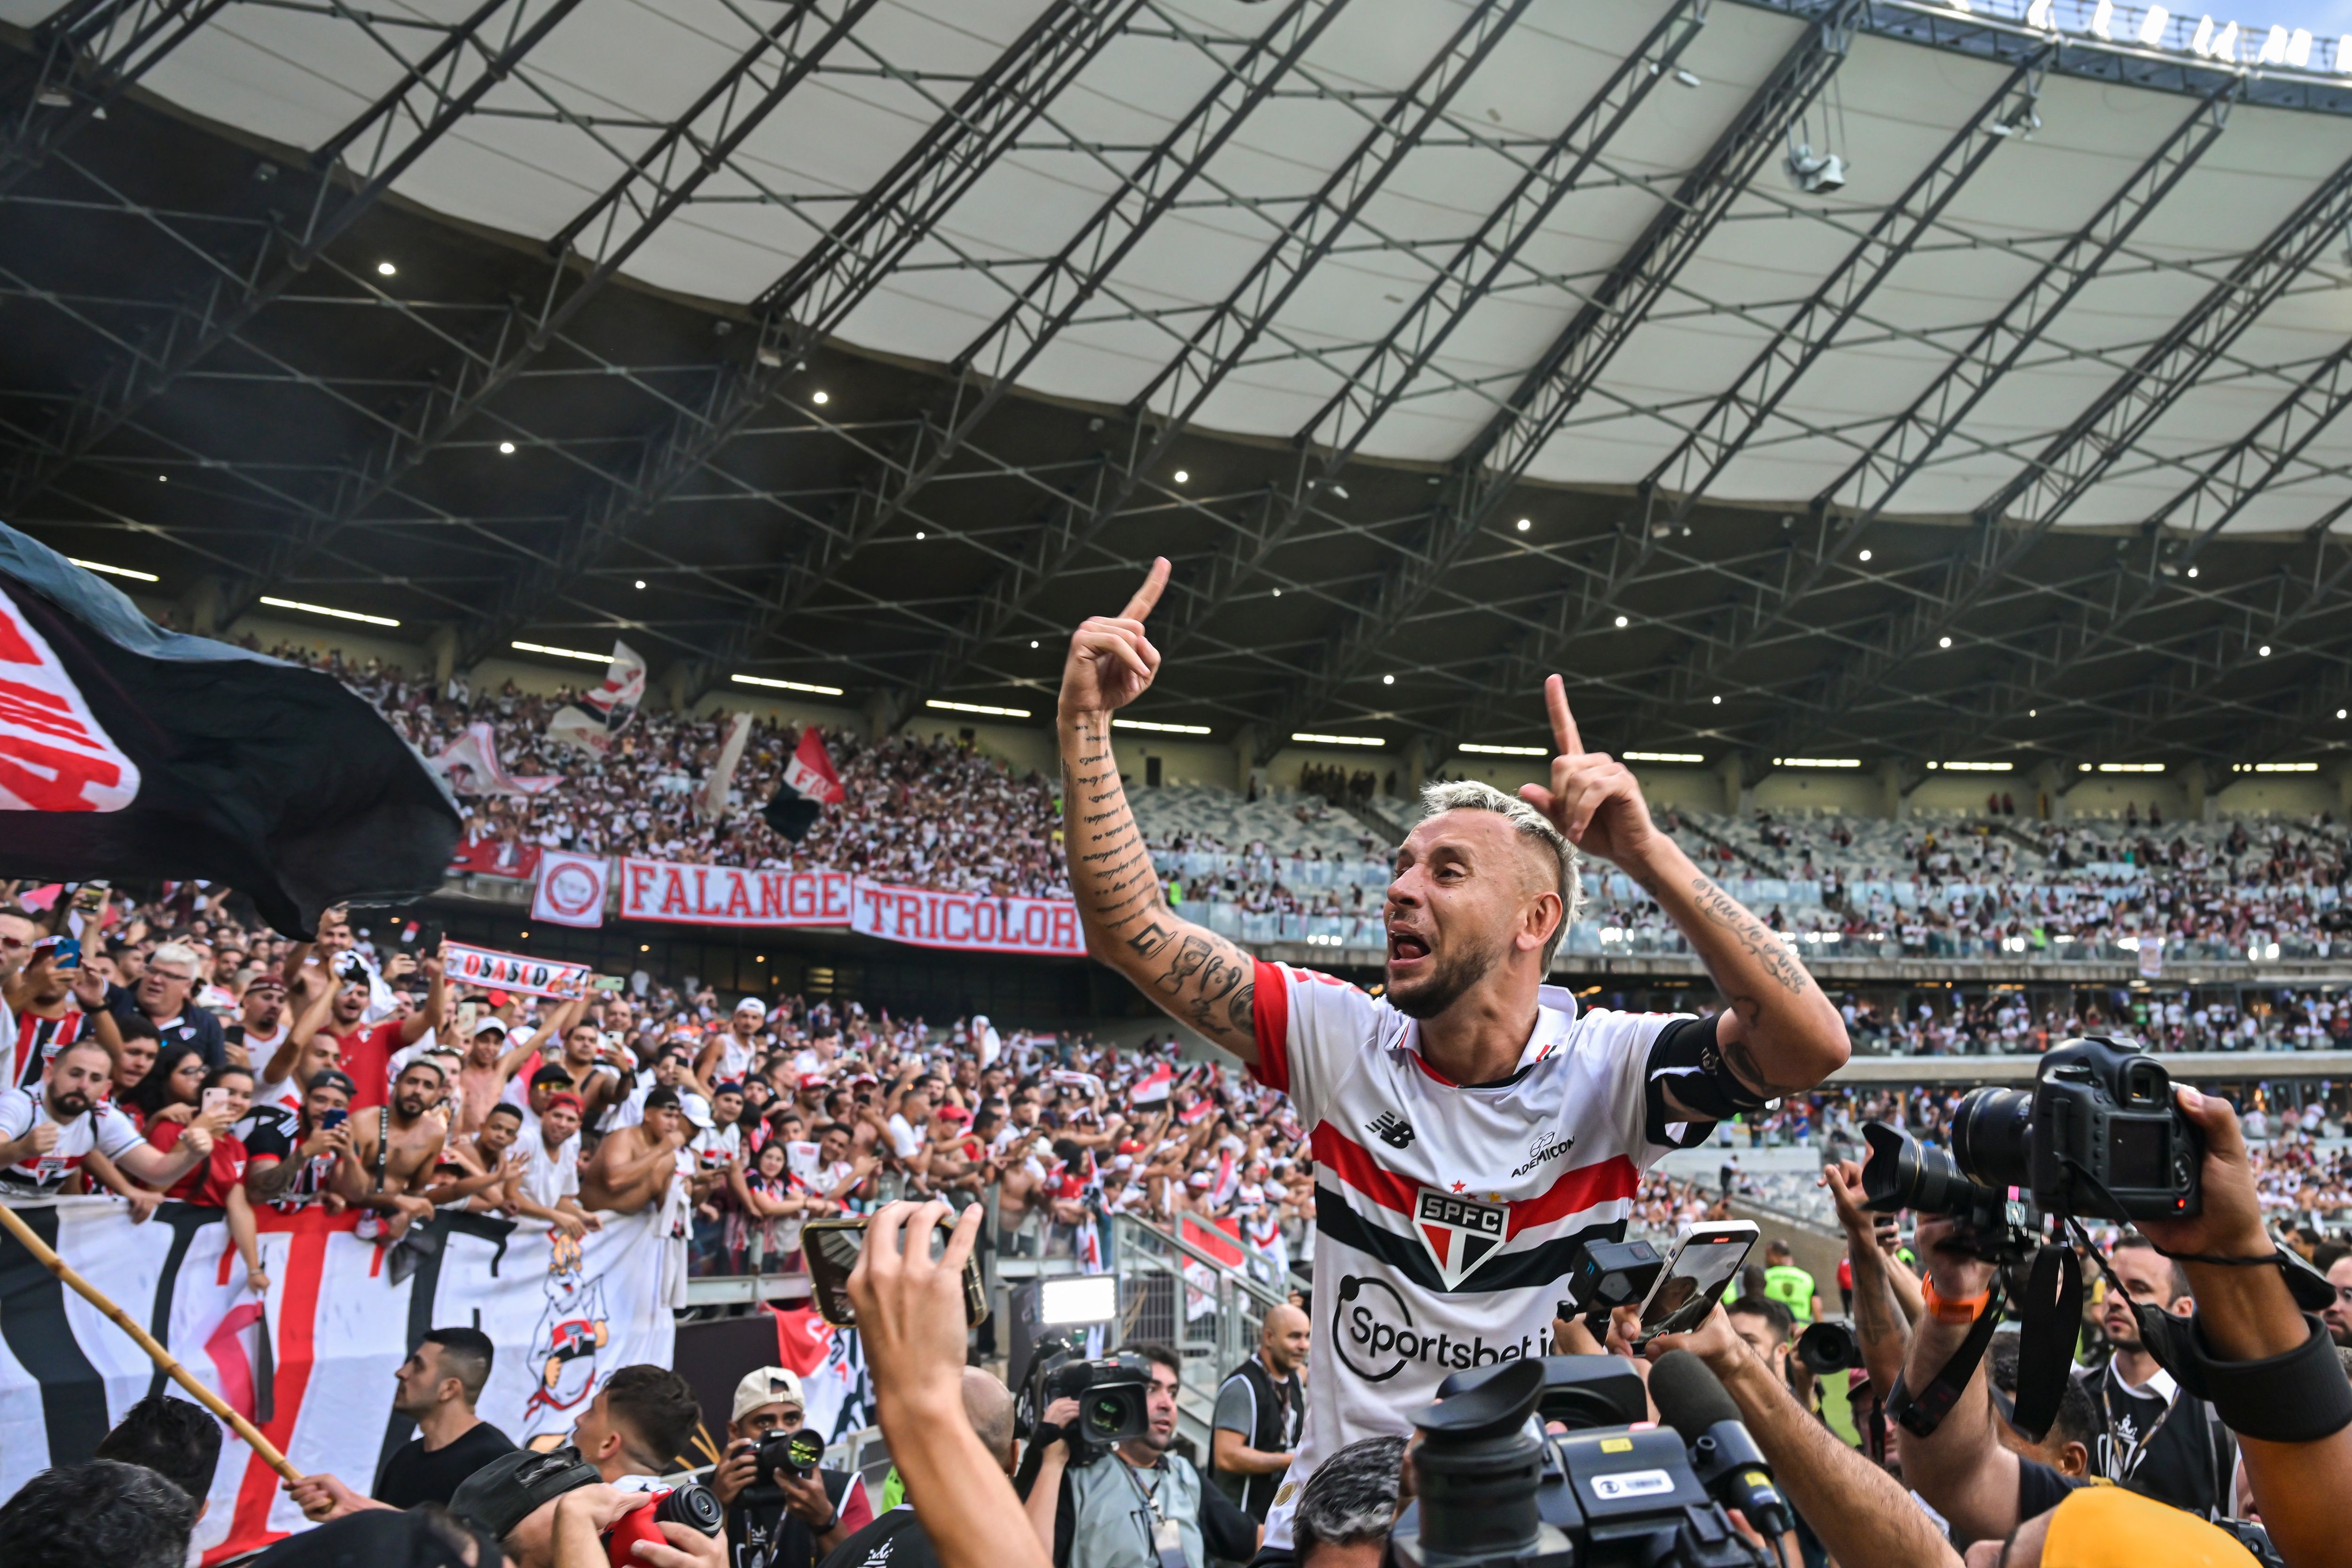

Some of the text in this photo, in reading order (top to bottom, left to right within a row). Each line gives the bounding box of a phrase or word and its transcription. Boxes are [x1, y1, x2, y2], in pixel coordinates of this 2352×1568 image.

[630, 864, 847, 917] FALANGE
[864, 890, 1078, 949] TRICOLOR
[463, 954, 549, 986] OSASCO
[1511, 1135, 1576, 1178] ADEMICON
[1424, 1197, 1499, 1231] SPFC
[1350, 1307, 1554, 1370] Sportsbeti
